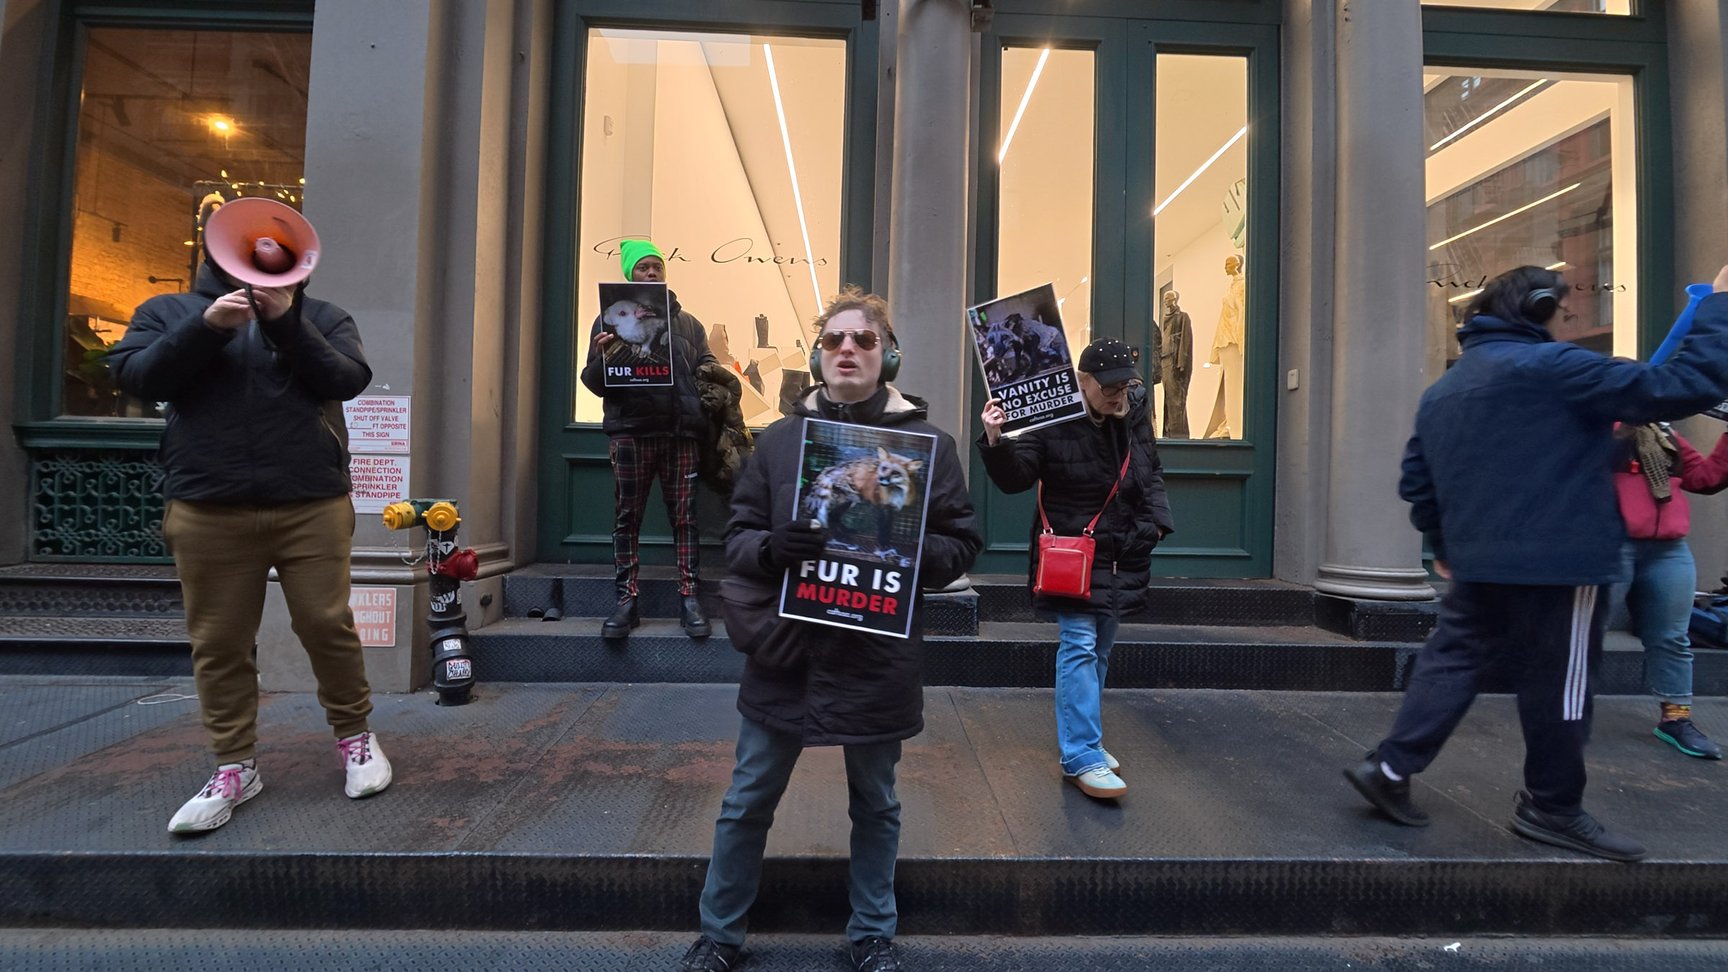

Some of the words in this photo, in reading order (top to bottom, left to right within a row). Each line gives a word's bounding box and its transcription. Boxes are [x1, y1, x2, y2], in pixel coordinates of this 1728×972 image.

[711, 238, 827, 265] Owens
[608, 366, 632, 376] FUR
[635, 366, 670, 376] KILLS
[998, 377, 1050, 400] VANITY
[1056, 372, 1069, 384] IS
[1002, 398, 1022, 411] NO
[1026, 383, 1072, 405] EXCUSE
[1006, 409, 1026, 421] FOR
[1029, 395, 1074, 414] MURDER
[353, 458, 371, 466] FIRE
[373, 458, 397, 466] DEPT.
[352, 483, 397, 491] SPRINKLER
[355, 491, 401, 499] STANDPIPE
[800, 559, 859, 587] FUR
[872, 568, 902, 593] IS
[796, 582, 898, 615] MURDER
